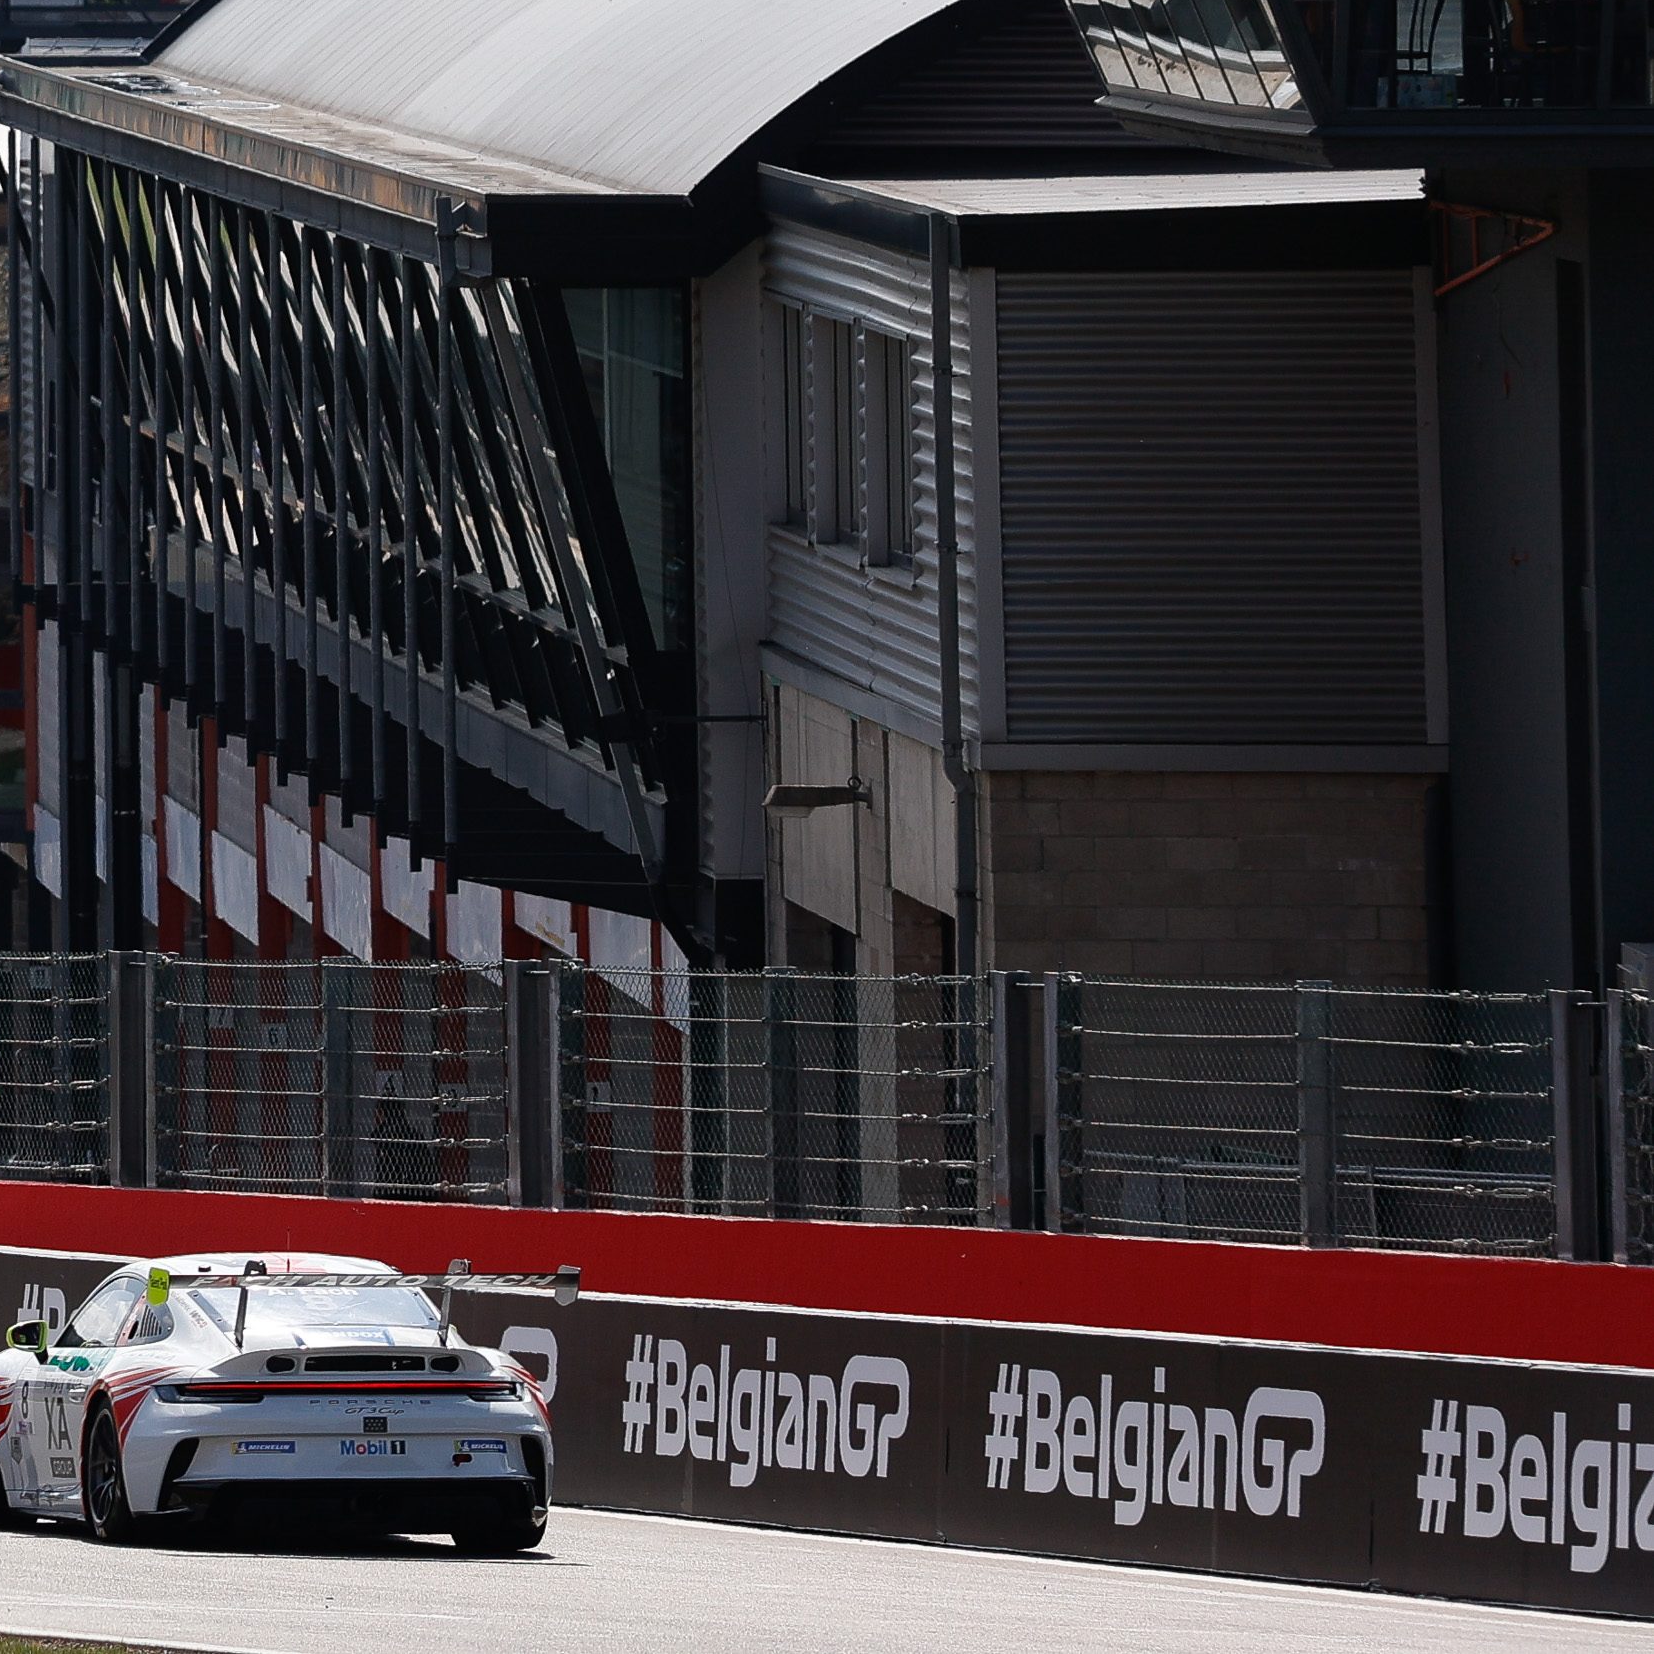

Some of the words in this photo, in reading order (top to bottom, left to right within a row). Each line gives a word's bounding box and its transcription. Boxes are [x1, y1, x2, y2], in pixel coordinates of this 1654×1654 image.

[317, 1274, 429, 1288] AUTO
[442, 1274, 556, 1287] TECH
[296, 1286, 360, 1297] Fach
[21, 1380, 30, 1420] 8
[308, 1398, 433, 1406] PORSCHE
[622, 1333, 911, 1488] #BelgianGP
[248, 1444, 292, 1452] MICHELIN
[340, 1439, 388, 1456] Mobil
[984, 1363, 1327, 1527] #BelgianGP
